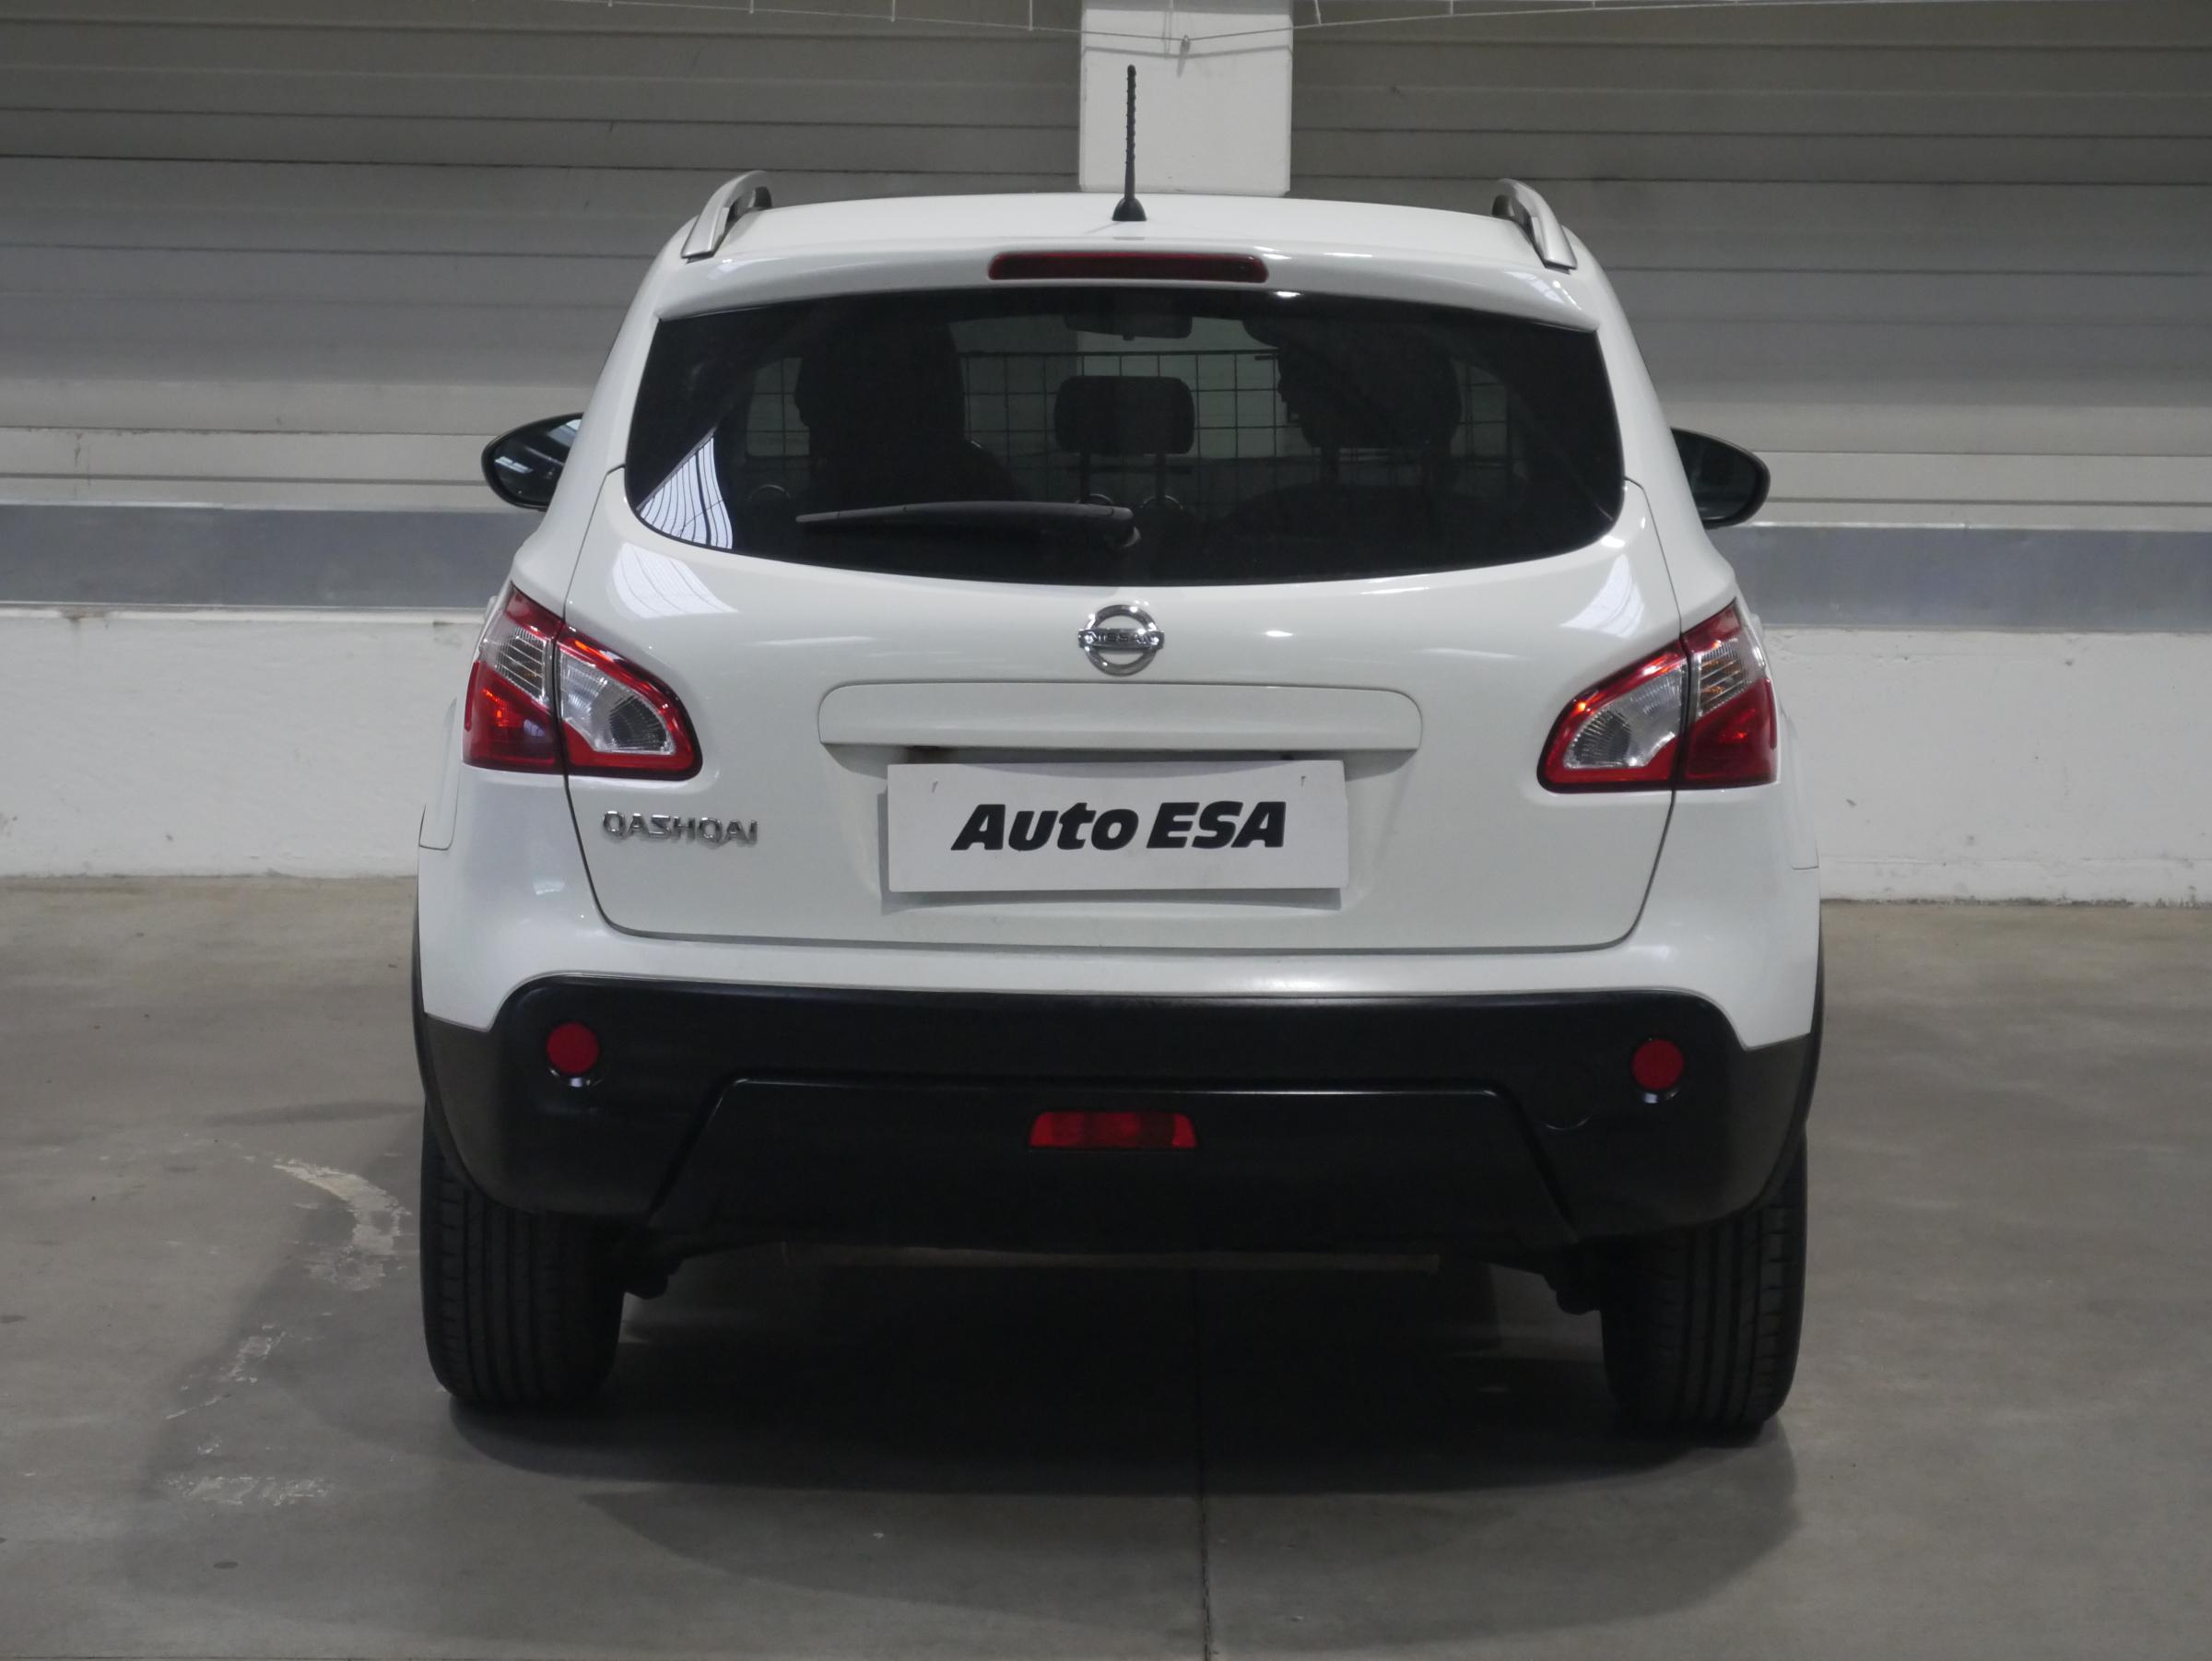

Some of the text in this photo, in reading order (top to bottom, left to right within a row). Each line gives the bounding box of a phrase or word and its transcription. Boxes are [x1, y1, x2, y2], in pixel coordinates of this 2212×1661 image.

[603, 810, 758, 846] QASHQAI
[950, 800, 1287, 852] Auto ESA
